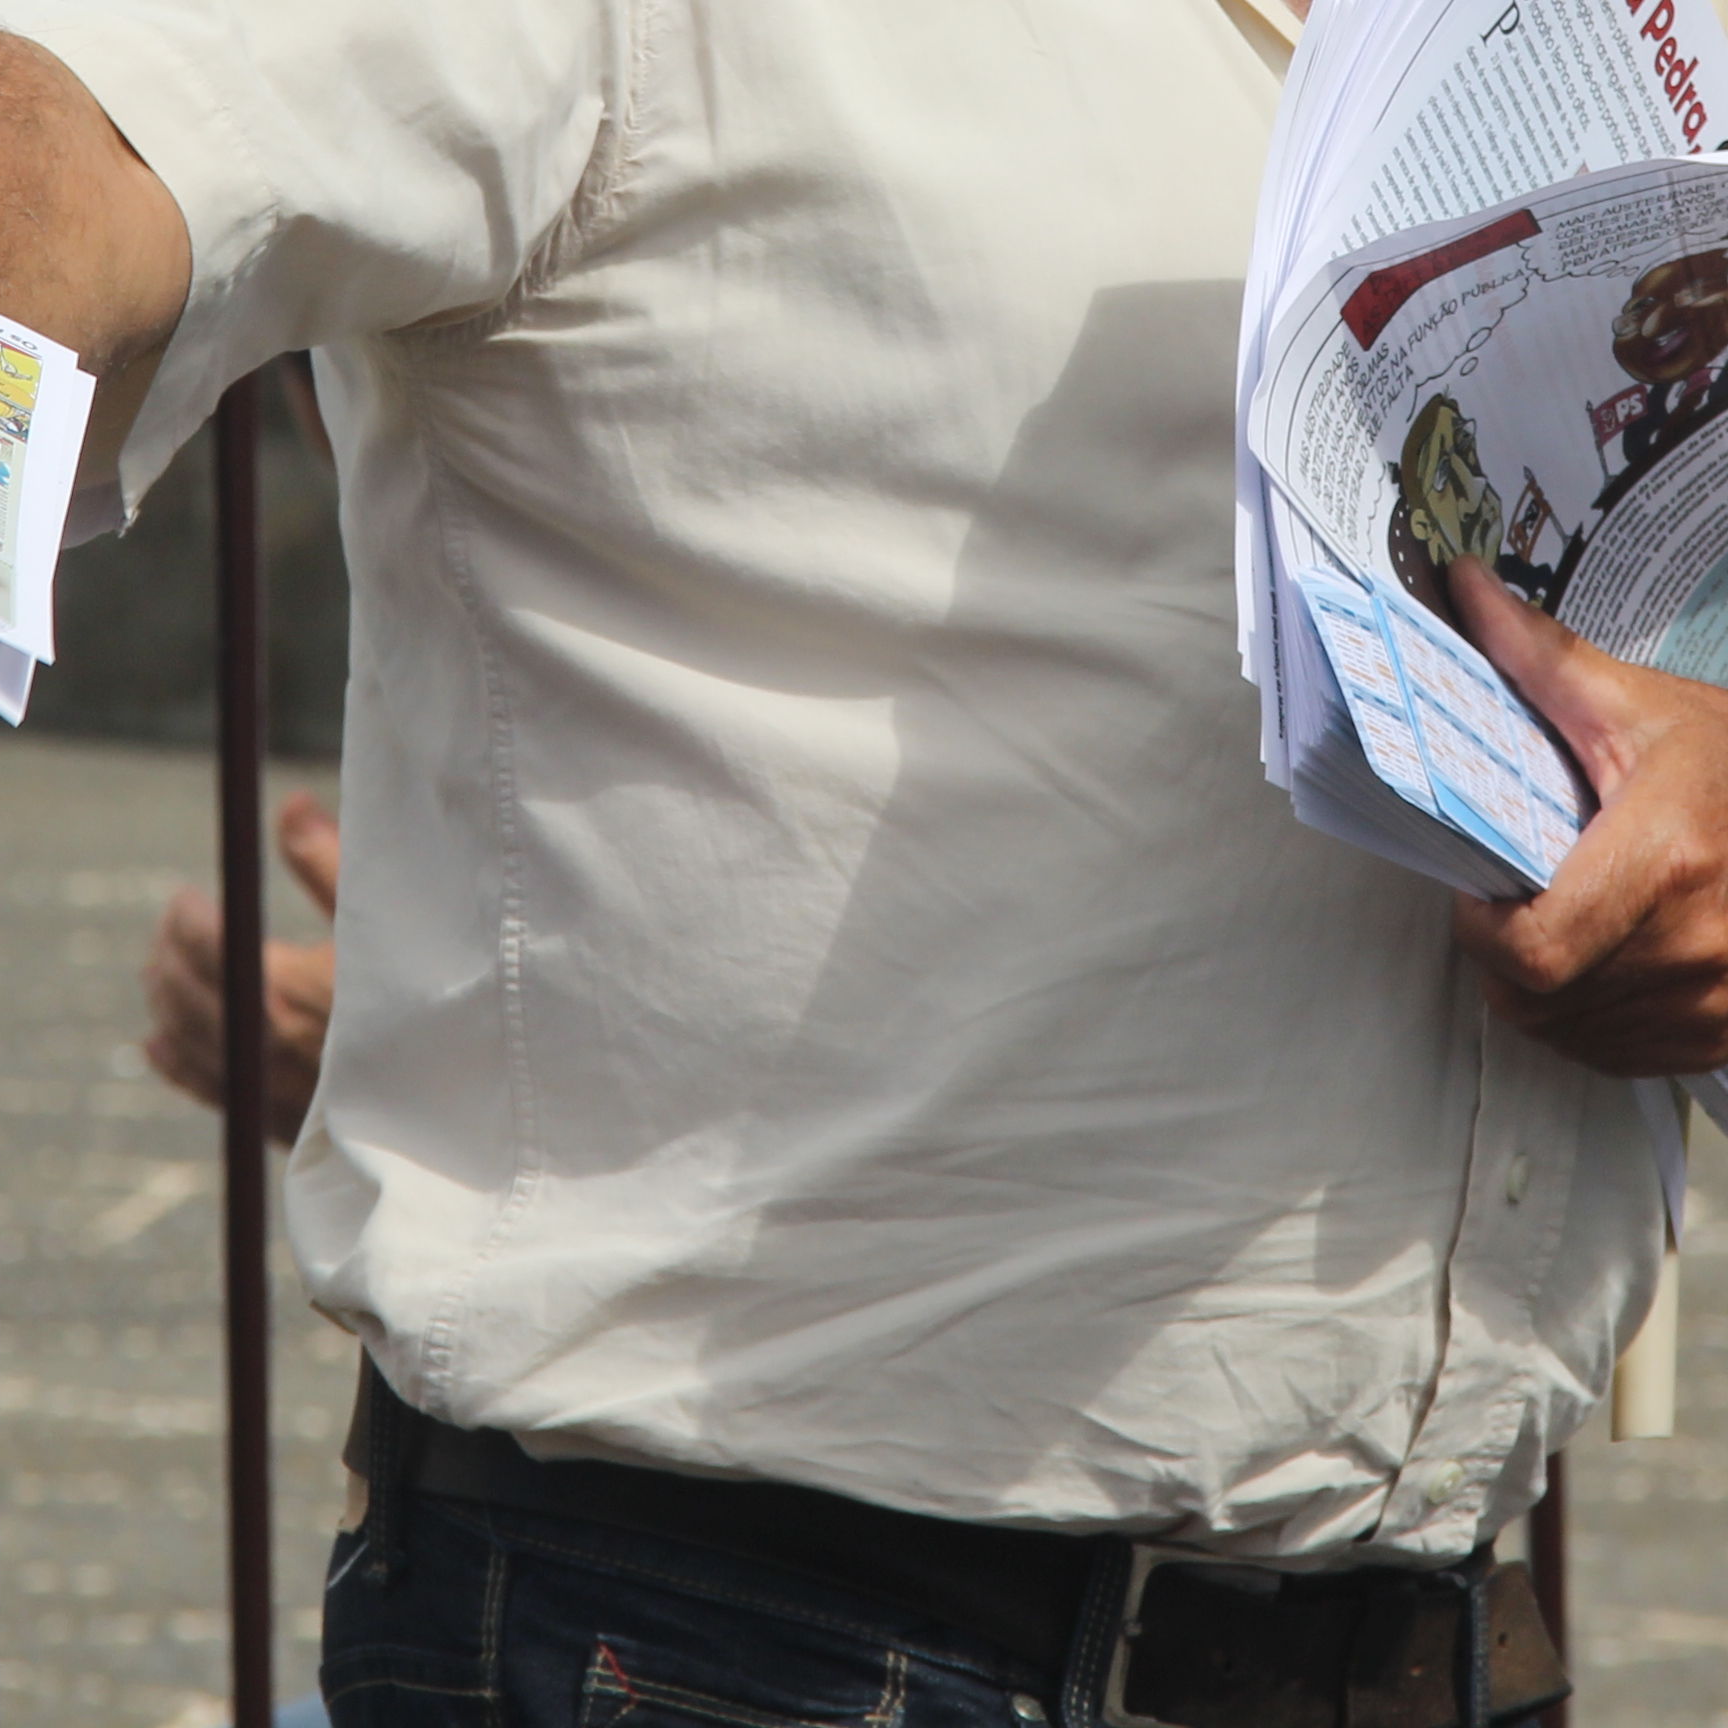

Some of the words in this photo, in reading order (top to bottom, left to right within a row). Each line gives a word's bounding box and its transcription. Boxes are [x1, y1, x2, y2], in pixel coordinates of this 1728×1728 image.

[1551, 46, 1572, 86] fecha
[1573, 95, 1594, 133] olhos.
[1569, 32, 1608, 112] mão-de-obra
[1593, 33, 1607, 61] mas
[1602, 55, 1631, 113] ninguém
[1626, 106, 1643, 138] sabe
[1613, 26, 1639, 76] público
[1633, 69, 1649, 99] que
[1553, 214, 1620, 240] CORTES
[1624, 206, 1652, 220] EM
[1669, 190, 1716, 208] ANOS
[1554, 210, 1596, 231] MAIS
[1601, 181, 1715, 217] AUSTERIDADE
[1557, 217, 1648, 250] REFORMAS
[1559, 239, 1597, 259] MAIS
[7, 331, 40, 351] Os
[1301, 339, 1352, 441] AUSTERIDADE
[1332, 419, 1345, 463] NAS
[1339, 339, 1390, 425] REFORMAS
[1336, 368, 1390, 501] DESPEDIMENTOS
[1388, 344, 1409, 373] NA
[1404, 297, 1461, 355] FUNÇÃO
[1459, 266, 1526, 307] PÚBLICA
[1364, 410, 1383, 447] QUE
[1379, 363, 1415, 418] FALTA
[1616, 394, 1643, 421] PS
[1311, 436, 1325, 498] CORTES
[1319, 411, 1332, 443] EM
[1333, 354, 1361, 401] ANOS
